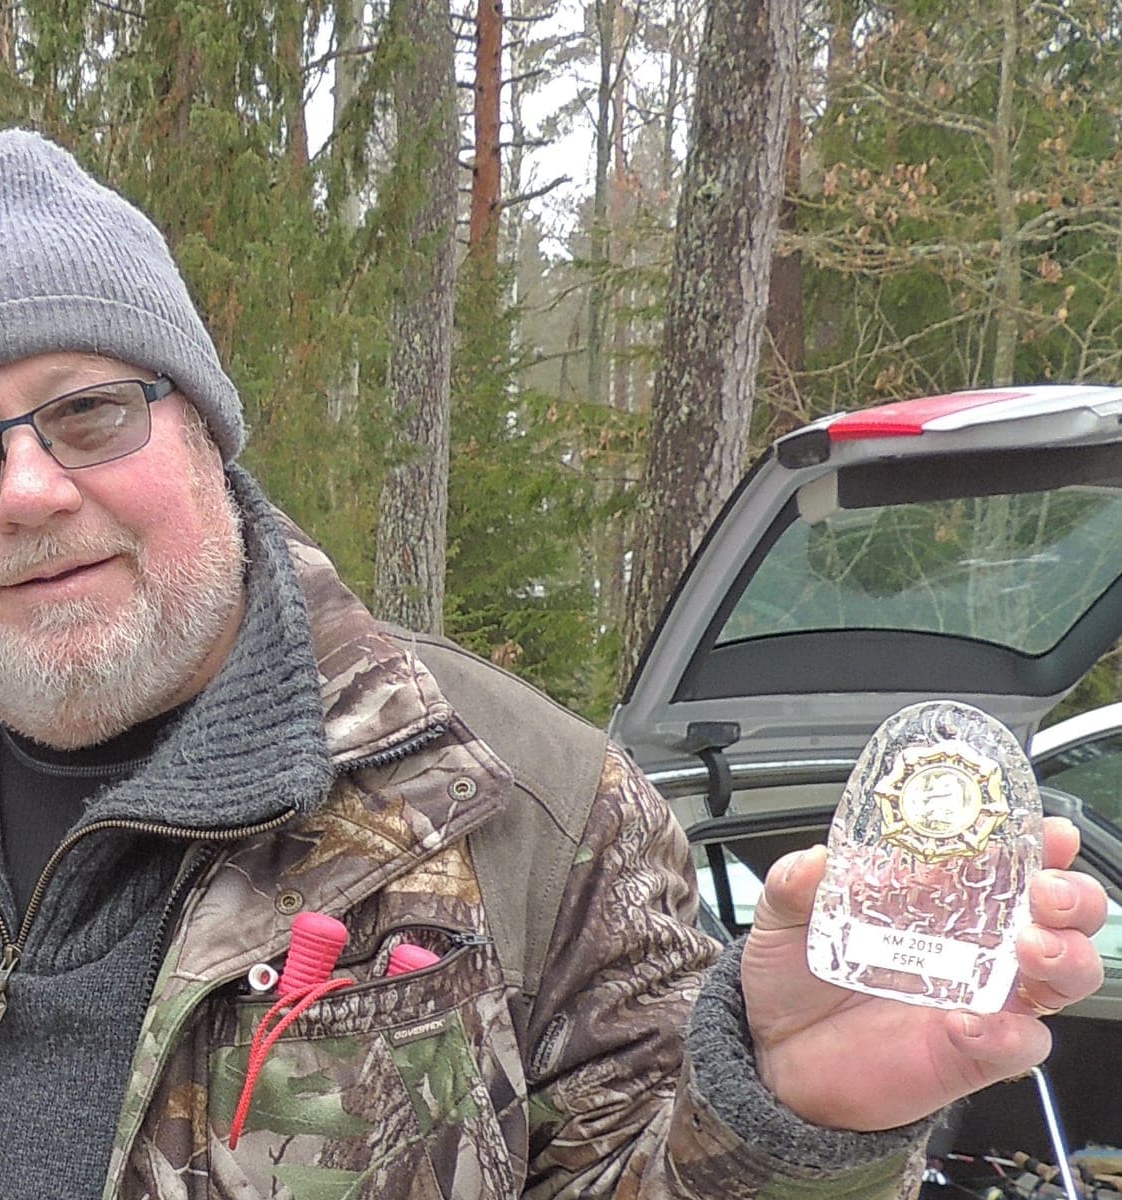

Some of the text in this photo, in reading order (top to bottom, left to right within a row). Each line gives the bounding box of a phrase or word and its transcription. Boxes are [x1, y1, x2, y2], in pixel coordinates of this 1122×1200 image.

[883, 934, 943, 954] KM 2019
[892, 952, 926, 968] FSFK
